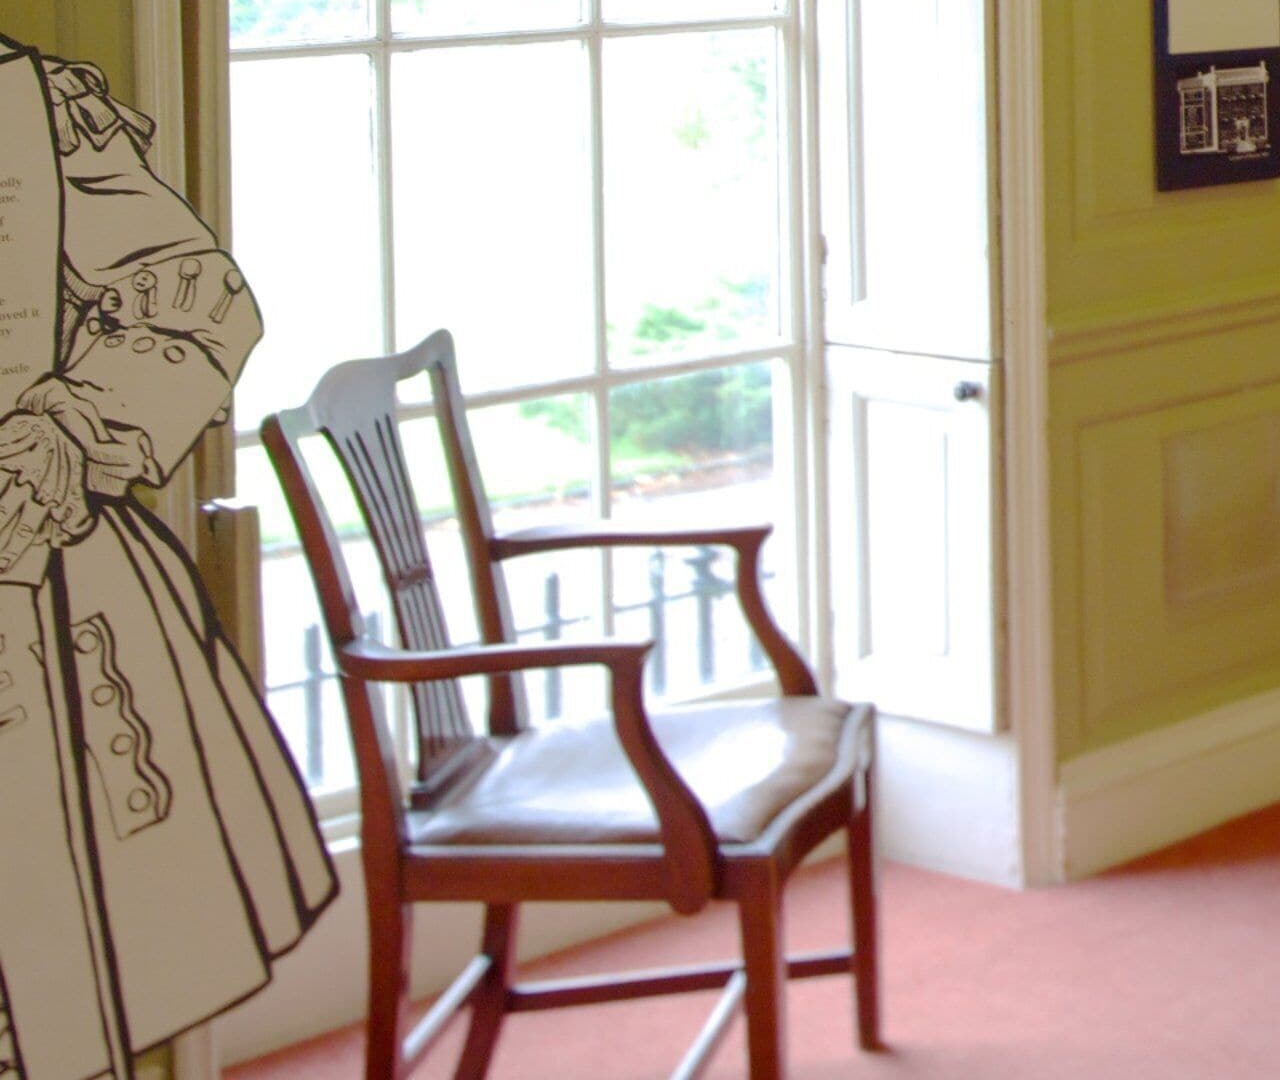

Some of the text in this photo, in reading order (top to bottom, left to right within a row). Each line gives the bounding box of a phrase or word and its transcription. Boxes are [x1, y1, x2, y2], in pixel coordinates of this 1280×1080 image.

[0, 177, 22, 191] olly
[0, 308, 27, 320] oved
[0, 364, 29, 376] astle
